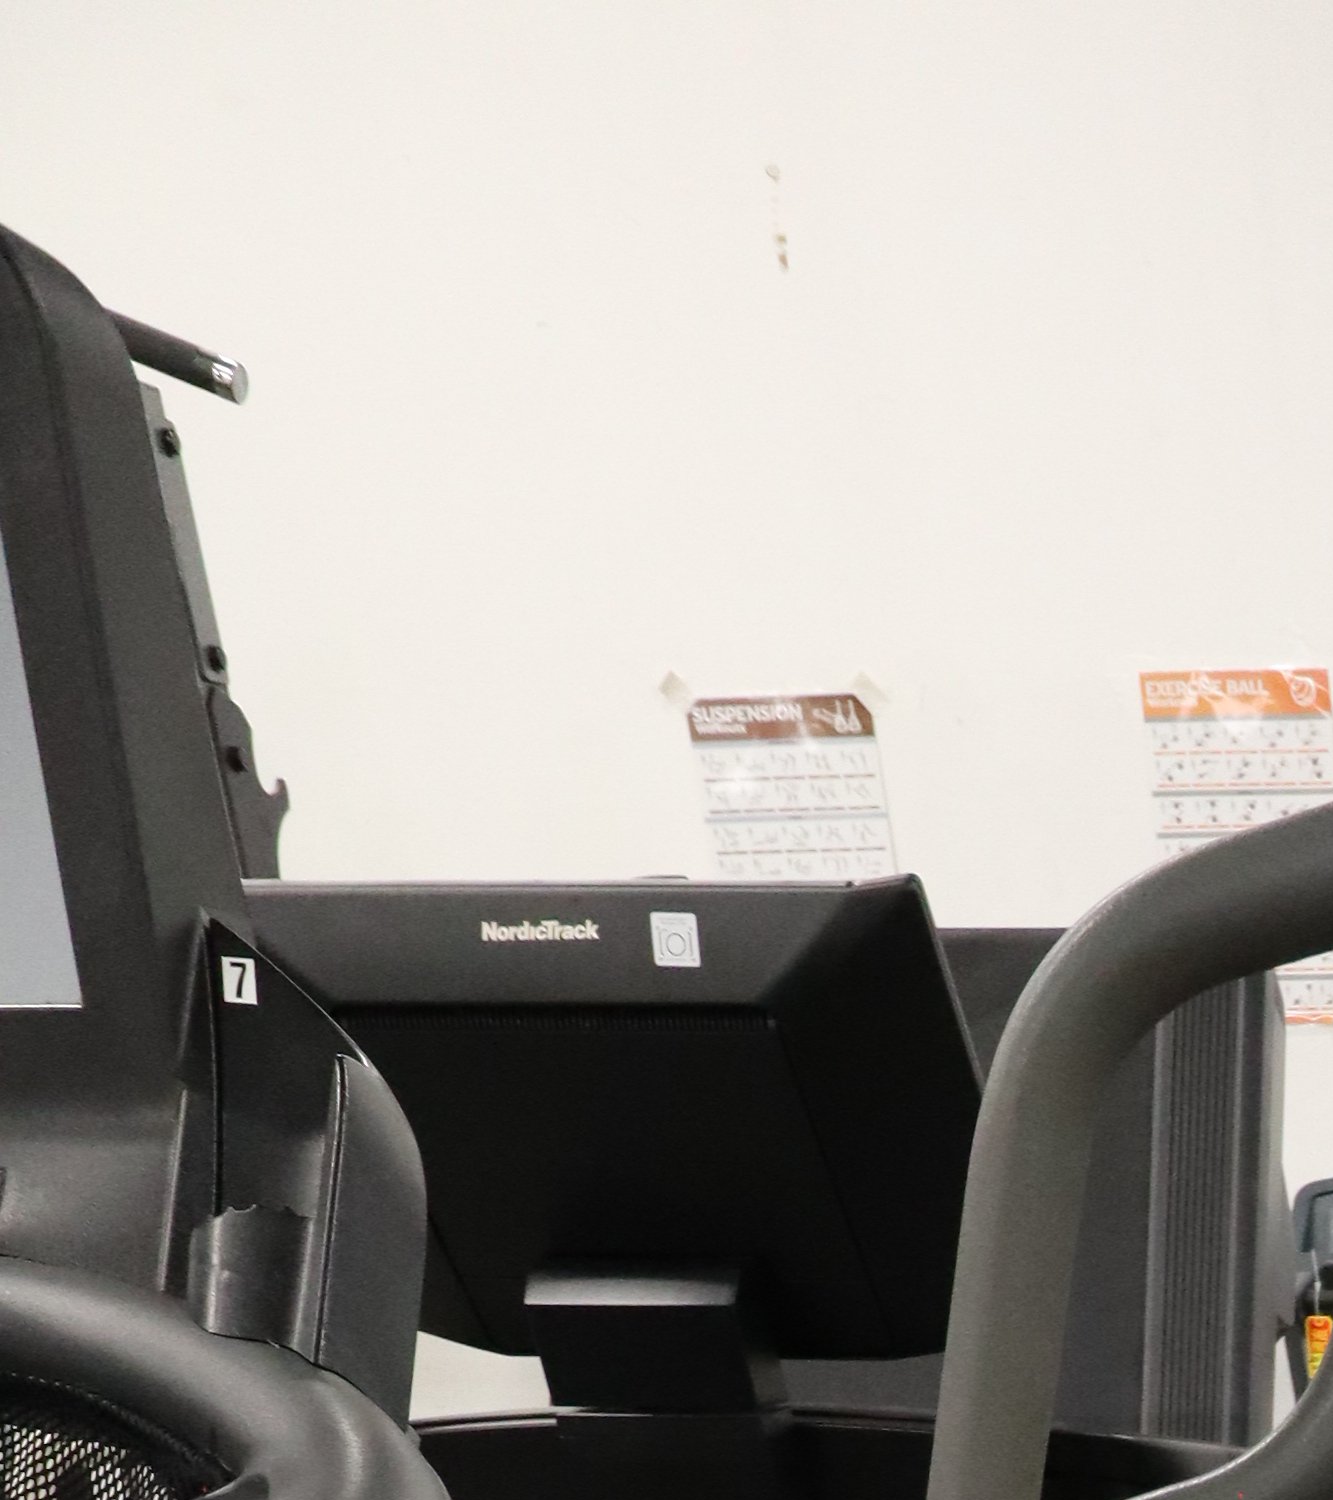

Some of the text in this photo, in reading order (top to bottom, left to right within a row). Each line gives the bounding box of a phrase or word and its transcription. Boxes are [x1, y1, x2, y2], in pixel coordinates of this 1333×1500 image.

[1226, 679, 1268, 696] BALL
[692, 702, 804, 724] SUSPENSION
[481, 919, 600, 942] NordicTrack
[229, 961, 247, 999] 7
